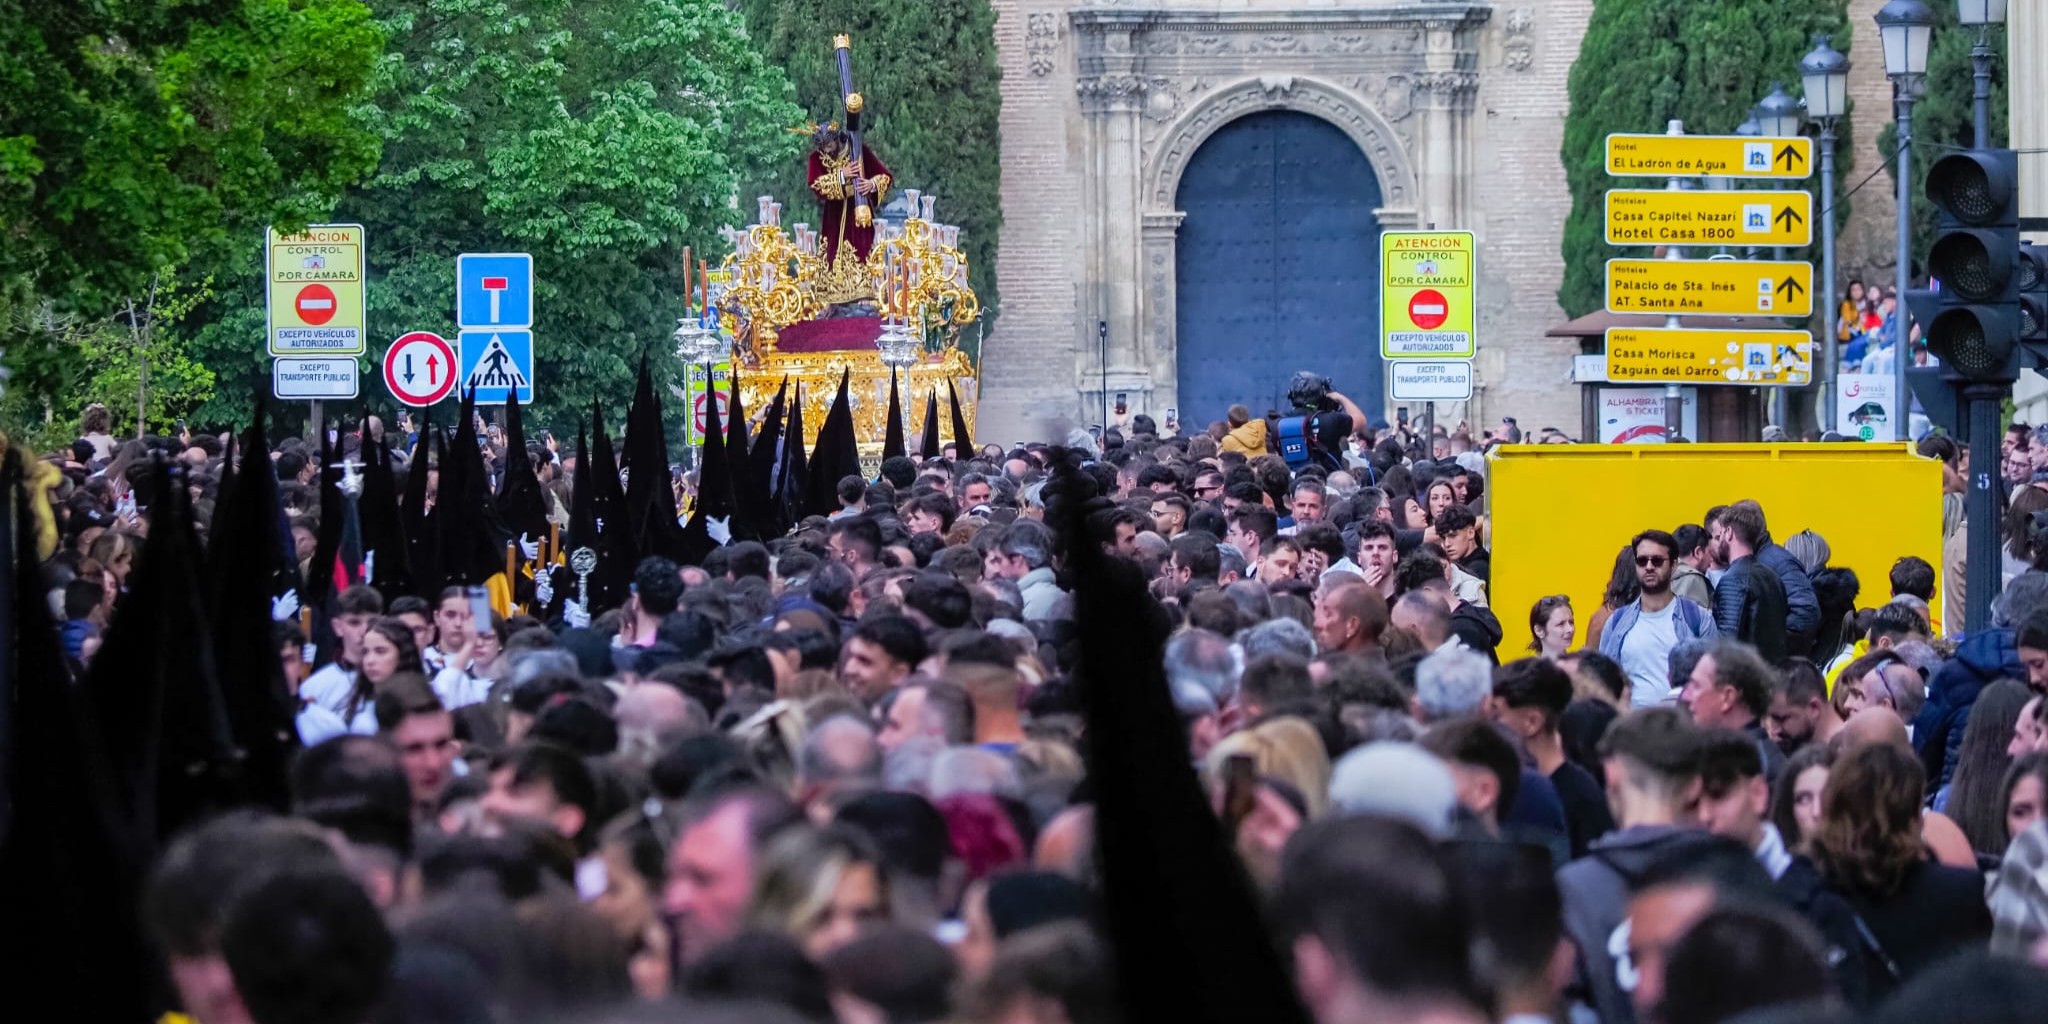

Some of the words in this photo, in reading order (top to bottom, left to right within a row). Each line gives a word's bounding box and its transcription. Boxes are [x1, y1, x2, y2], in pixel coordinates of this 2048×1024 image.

[1614, 157, 1625, 168] El
[1676, 159, 1691, 169] de
[1696, 159, 1727, 171] Agua
[1613, 211, 1643, 221] Casa
[1649, 211, 1692, 223] Capitel
[1697, 210, 1737, 221] Nazarí
[1613, 227, 1654, 239] Hotel
[1660, 227, 1695, 239] Casa
[1702, 228, 1735, 239] 1800
[1395, 236, 1461, 248] ATENCIÓN
[287, 246, 343, 255] CONTROL
[1400, 252, 1455, 260] CONTROL
[278, 271, 302, 280] POR
[1390, 276, 1414, 285] POR
[1615, 280, 1658, 291] Palacio
[1663, 282, 1677, 291] de
[1639, 297, 1675, 308] Santa
[1680, 298, 1703, 308] Ana
[279, 330, 312, 338] EXCEPTO
[1391, 334, 1423, 342] EXCEPTO
[291, 339, 344, 348] AUTORIZADOS
[1402, 343, 1454, 351] AUTORIZADOS
[1614, 348, 1643, 359] Casa
[1649, 349, 1695, 360] Morisca
[300, 363, 330, 371] EXCEPTO
[1417, 366, 1445, 374] EXCEPTO
[1613, 364, 1657, 377] Zaguán
[1662, 366, 1679, 376] del
[1685, 366, 1719, 377] Darro
[280, 373, 323, 381] TRANSPORTE
[1397, 376, 1438, 384] TRANSPORTE
[1607, 398, 1657, 408] ALHAMBRA
[1977, 473, 1990, 490] 5
